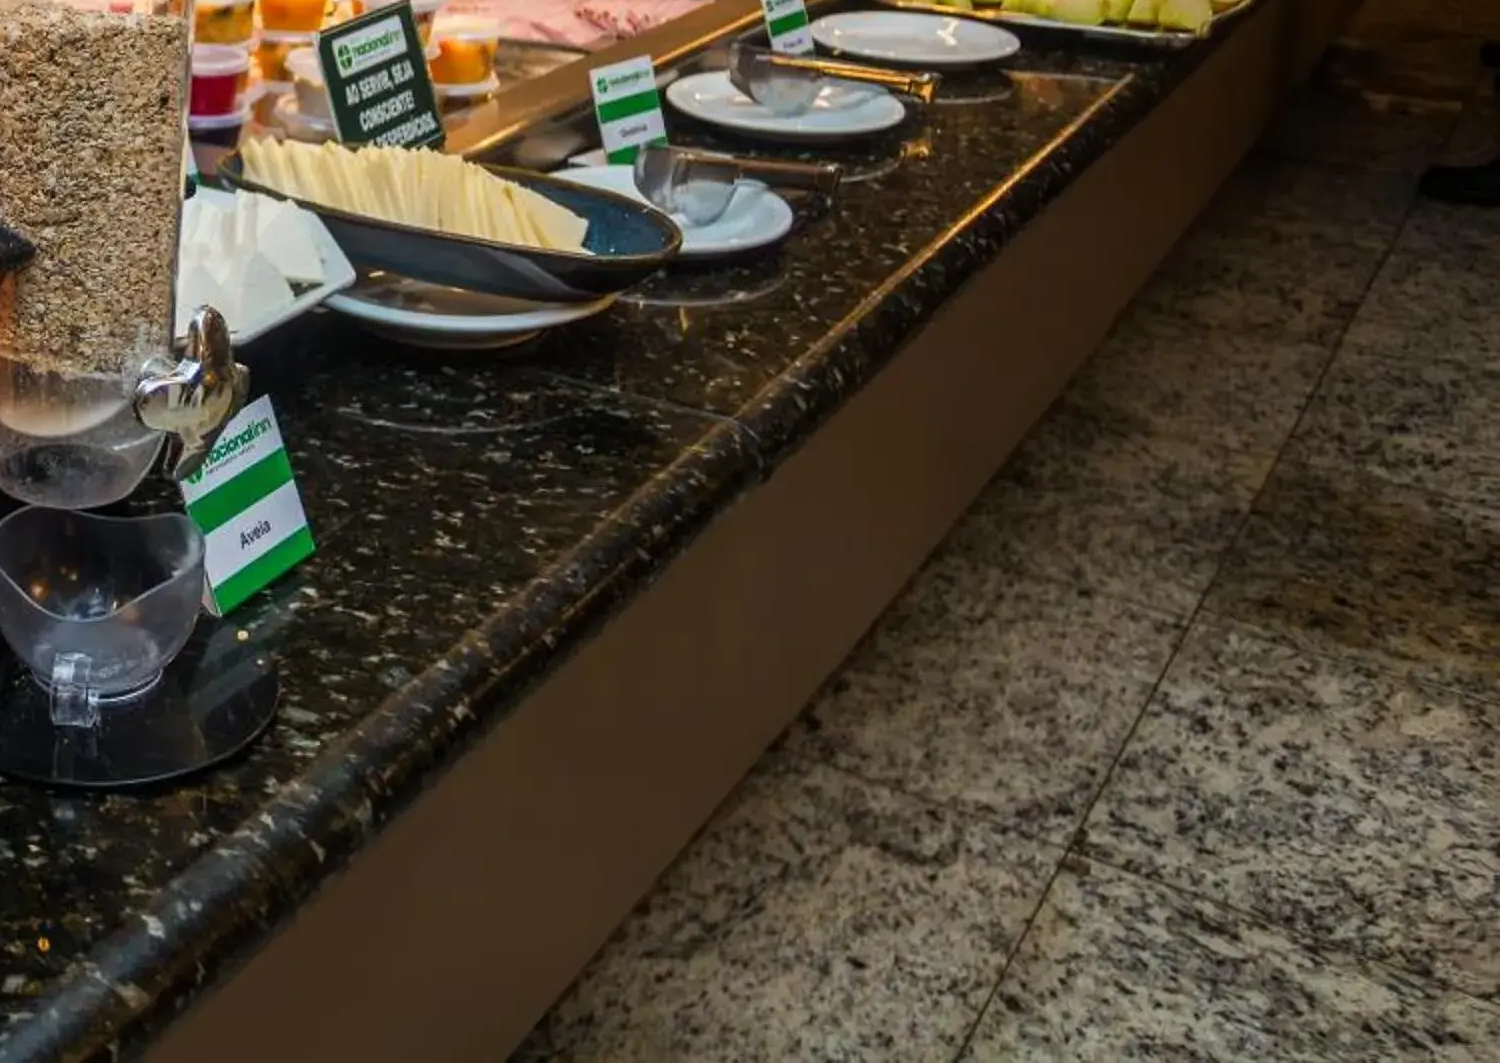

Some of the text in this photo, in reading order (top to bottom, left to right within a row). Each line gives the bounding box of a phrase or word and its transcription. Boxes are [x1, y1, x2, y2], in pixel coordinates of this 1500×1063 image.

[345, 83, 360, 105] AO
[391, 59, 415, 84] SEJA
[239, 520, 271, 549] Aveia
